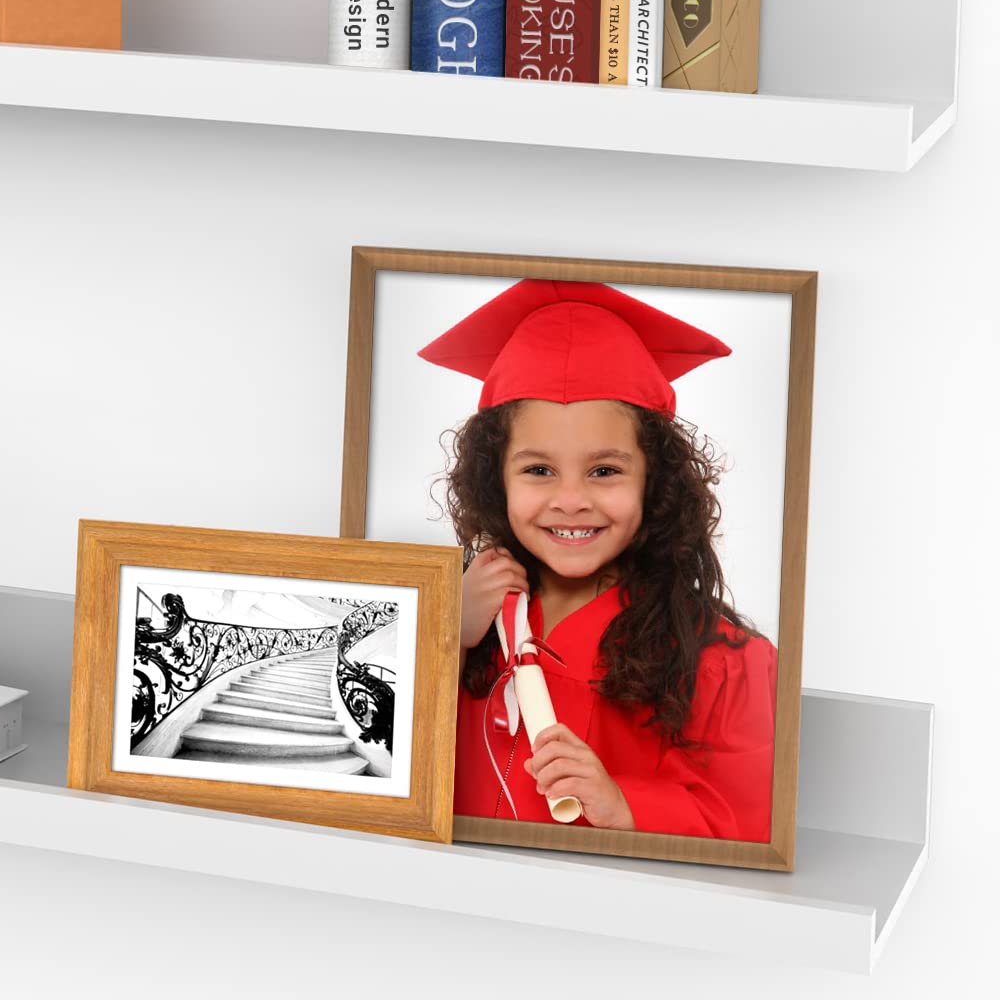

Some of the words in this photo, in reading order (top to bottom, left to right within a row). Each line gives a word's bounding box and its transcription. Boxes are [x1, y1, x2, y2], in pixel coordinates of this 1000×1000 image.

[609, 5, 620, 44] THAN
[608, 47, 619, 68] $10
[607, 73, 618, 83] A
